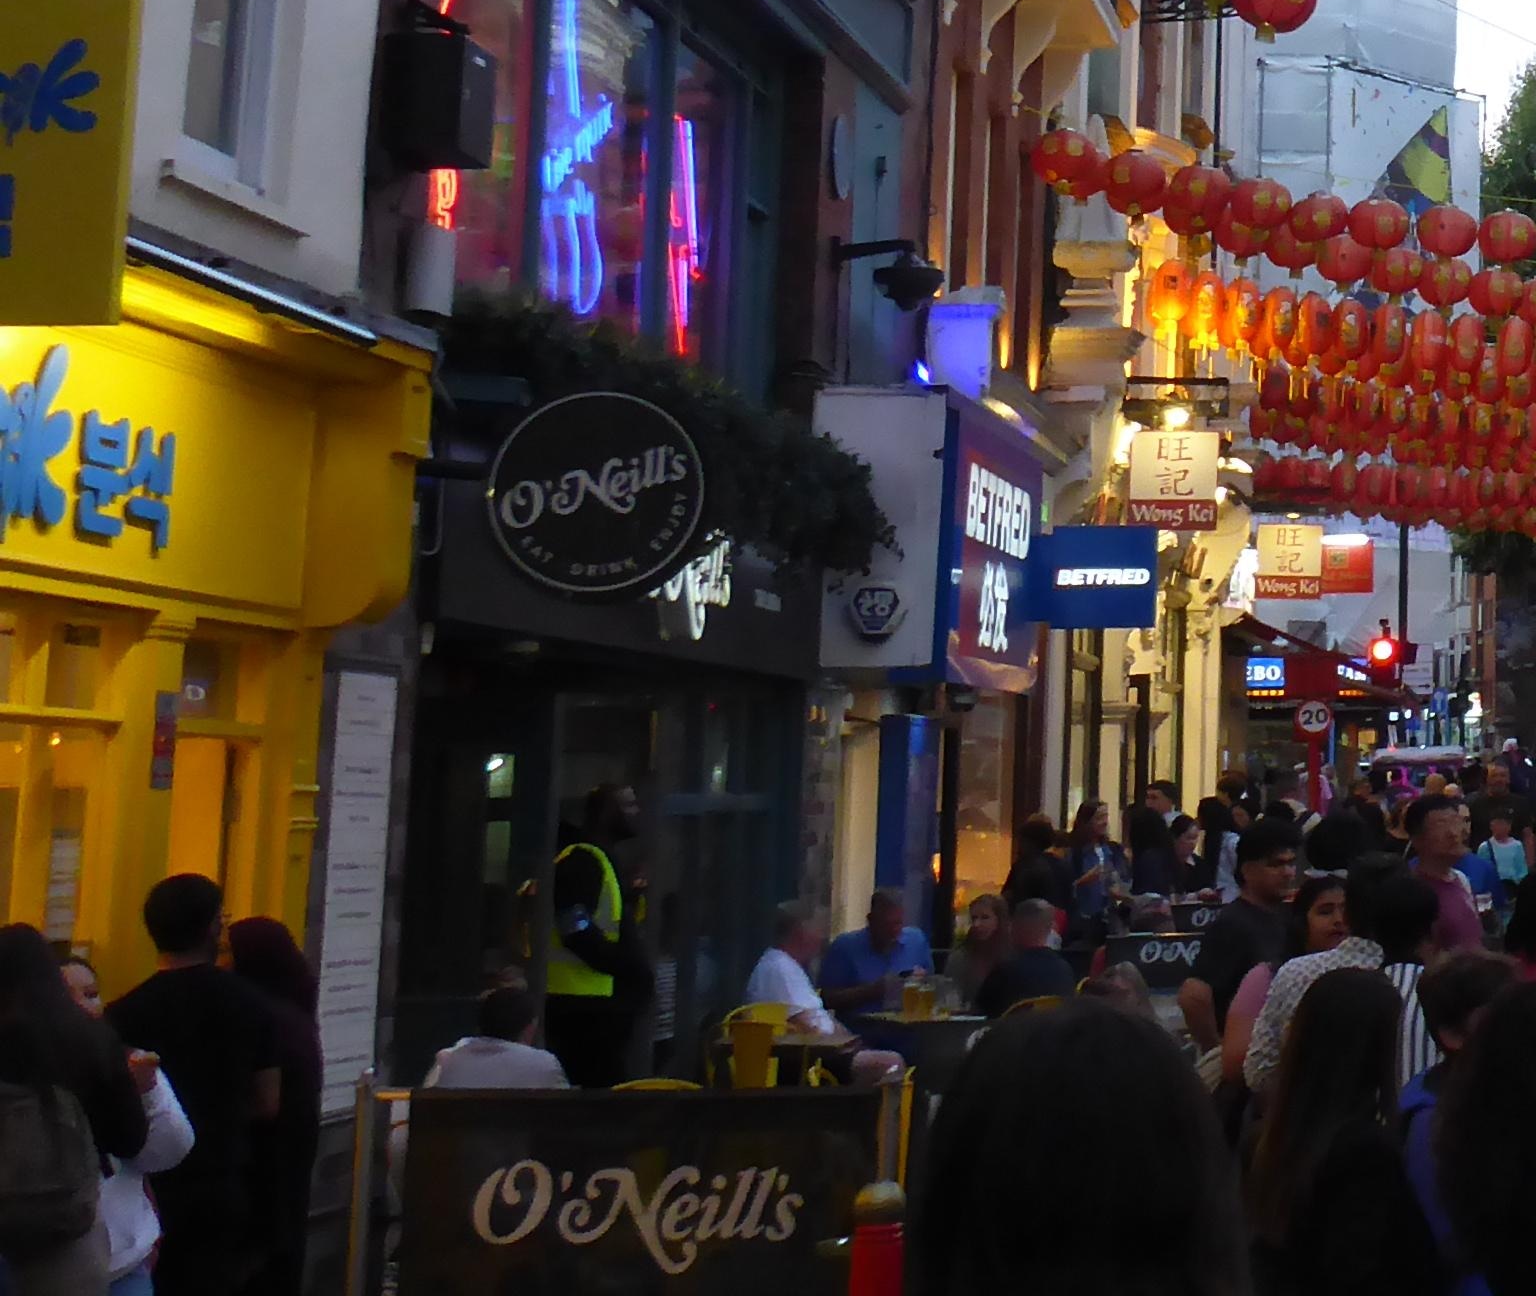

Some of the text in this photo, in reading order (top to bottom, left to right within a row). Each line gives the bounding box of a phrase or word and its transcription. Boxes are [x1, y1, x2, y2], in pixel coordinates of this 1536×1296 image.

[77, 410, 175, 552] 분식
[501, 445, 688, 529] O'Neill's
[1156, 436, 1194, 497] 旺記
[965, 462, 1032, 560] BETFRED
[1132, 503, 1215, 527] Wong Kei
[1056, 568, 1151, 586] BETFRED
[1276, 527, 1304, 574] 旺記
[1257, 577, 1298, 597] Wong
[1302, 708, 1327, 725] 20
[473, 1159, 804, 1275] O'Neill's
